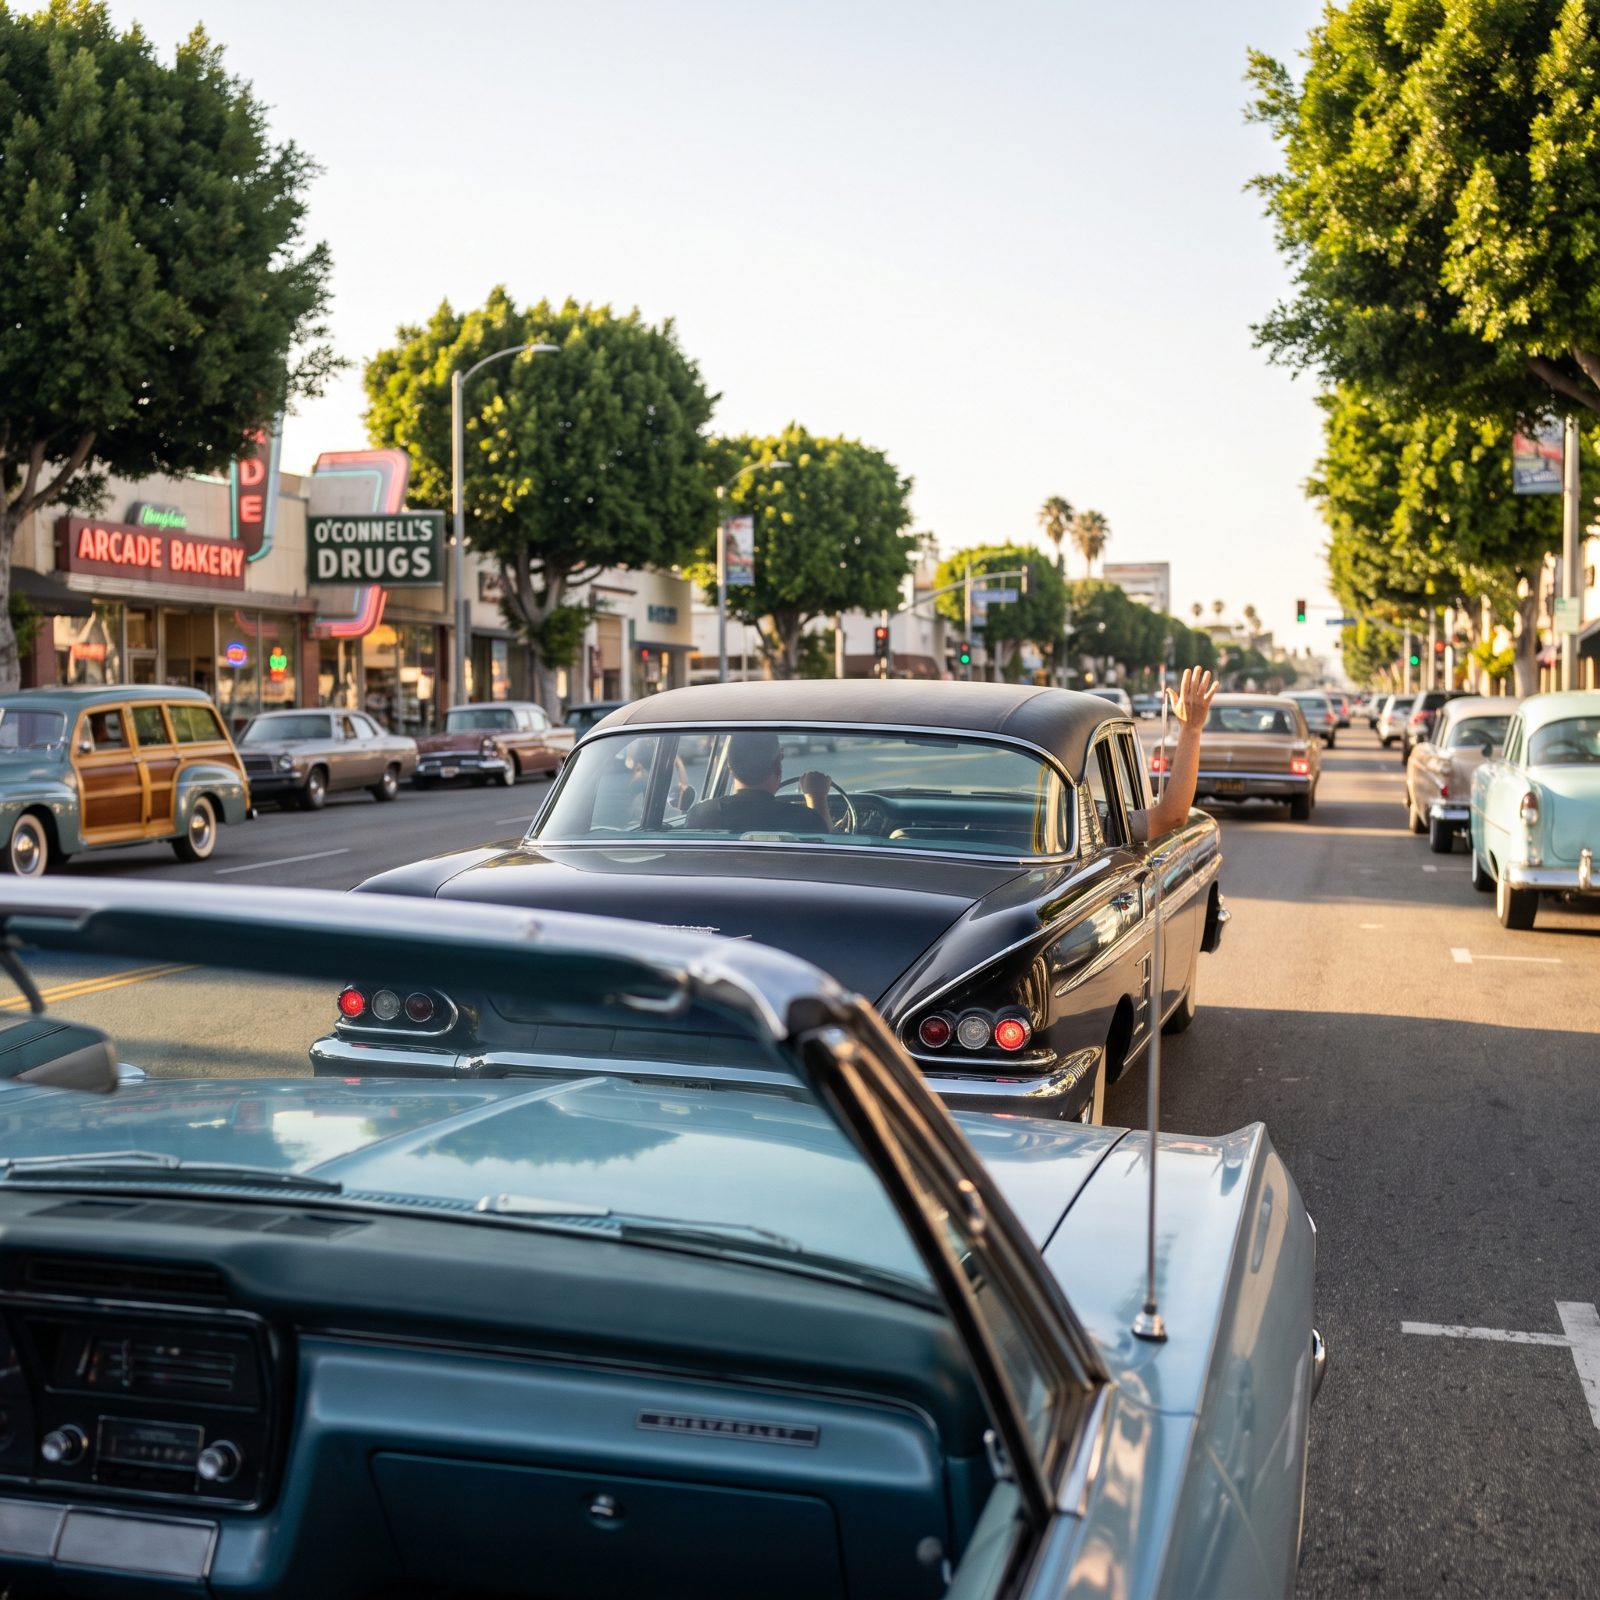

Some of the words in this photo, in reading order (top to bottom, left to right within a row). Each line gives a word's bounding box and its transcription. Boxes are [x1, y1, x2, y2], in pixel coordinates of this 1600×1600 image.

[314, 519, 433, 543] O'CONNELL'S
[79, 527, 162, 568] ARCADE
[170, 539, 244, 578] BAKERY
[318, 546, 432, 578] DRUGS
